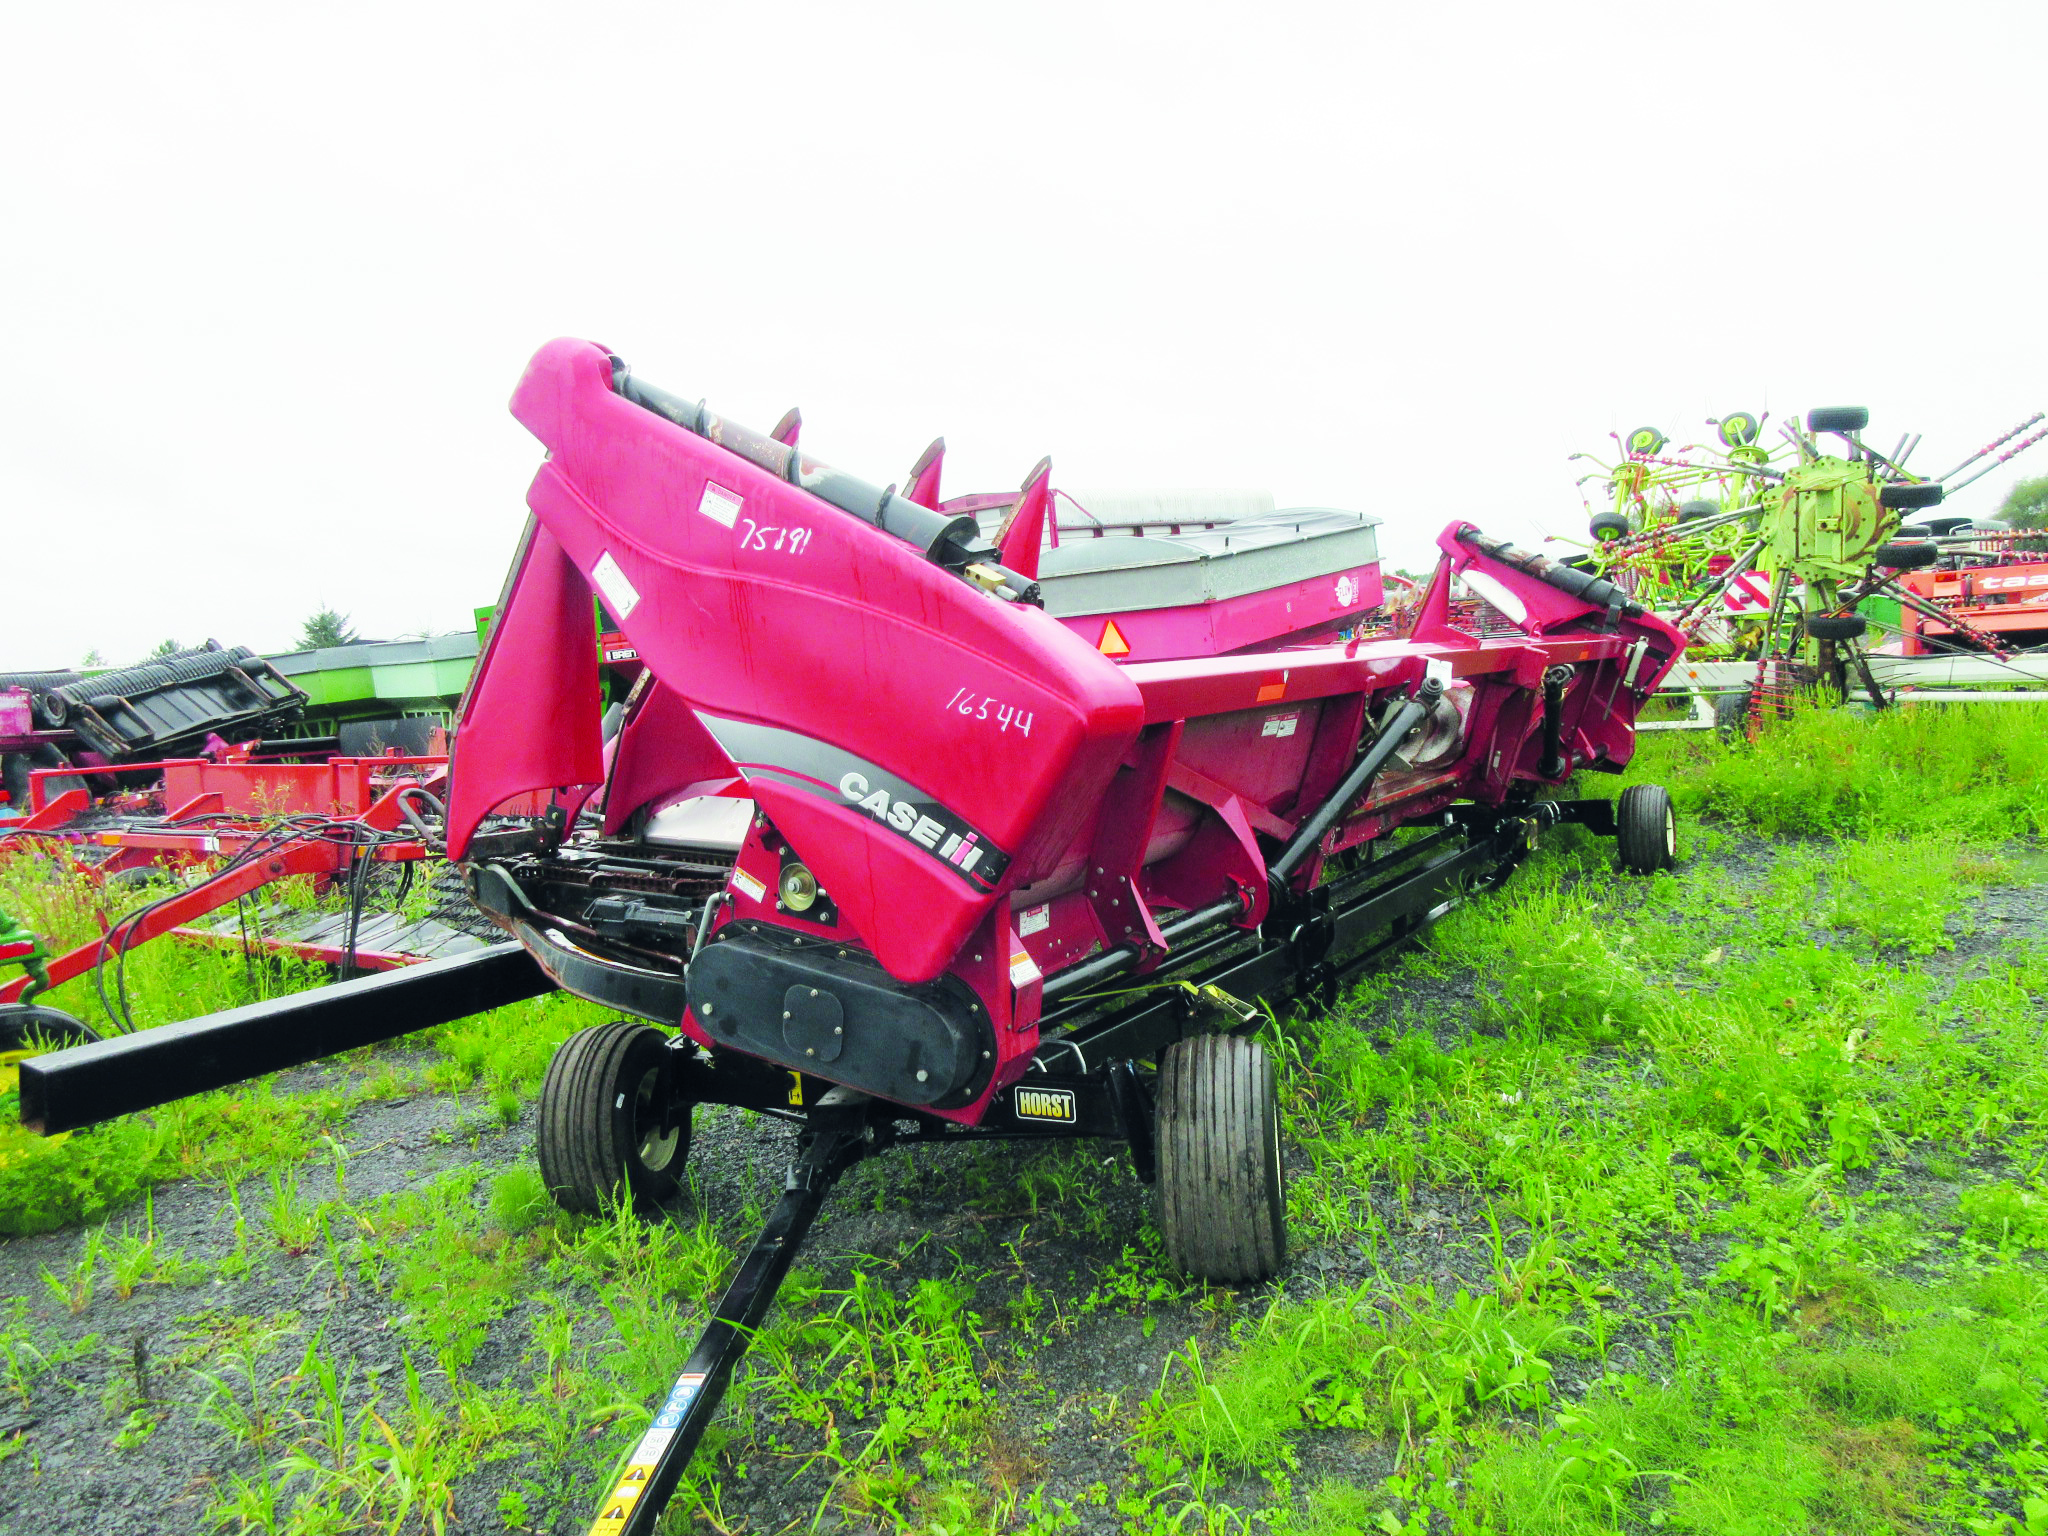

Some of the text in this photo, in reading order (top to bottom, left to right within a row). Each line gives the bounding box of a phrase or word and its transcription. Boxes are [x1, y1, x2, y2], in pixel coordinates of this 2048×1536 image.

[741, 518, 812, 555] 75191
[946, 687, 1034, 737] 16544
[839, 772, 947, 849] CASE
[1019, 1092, 1072, 1118] HORST
